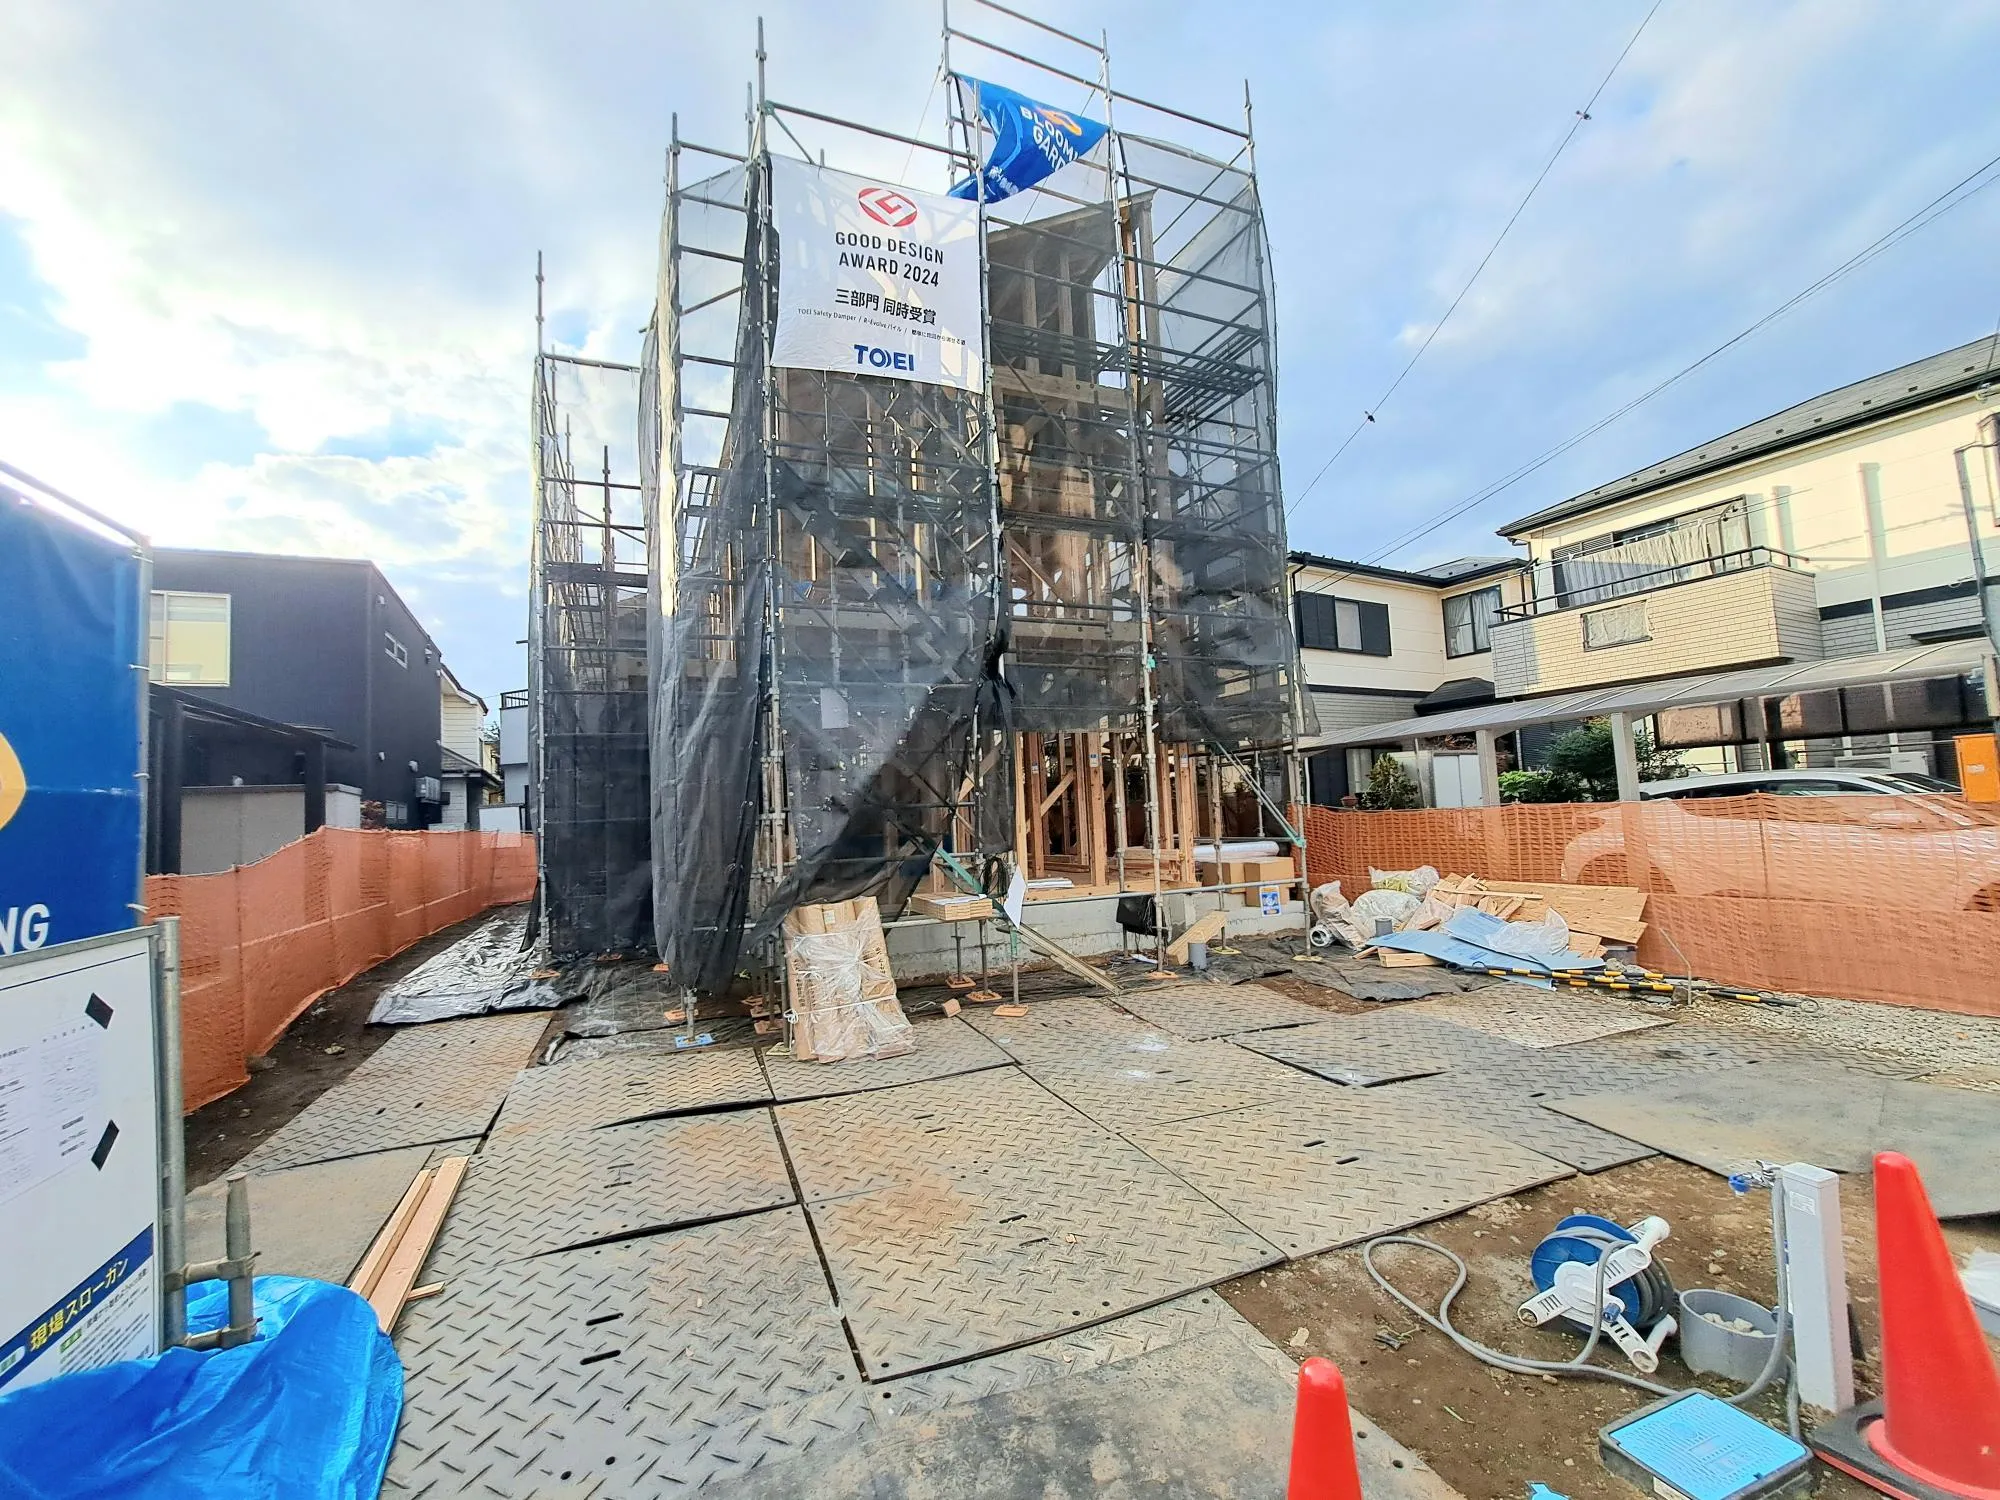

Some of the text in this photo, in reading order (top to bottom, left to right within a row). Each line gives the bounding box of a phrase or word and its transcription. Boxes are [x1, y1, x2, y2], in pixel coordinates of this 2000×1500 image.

[835, 231, 944, 265] GOOD DESIGN
[838, 251, 940, 288] AWARD 2024
[813, 309, 832, 319] Safety
[833, 312, 857, 321] Damper
[834, 288, 937, 326] 三部門 同時受賞
[854, 344, 914, 372] TOEI
[29, 1257, 128, 1352] 現場スローガン
